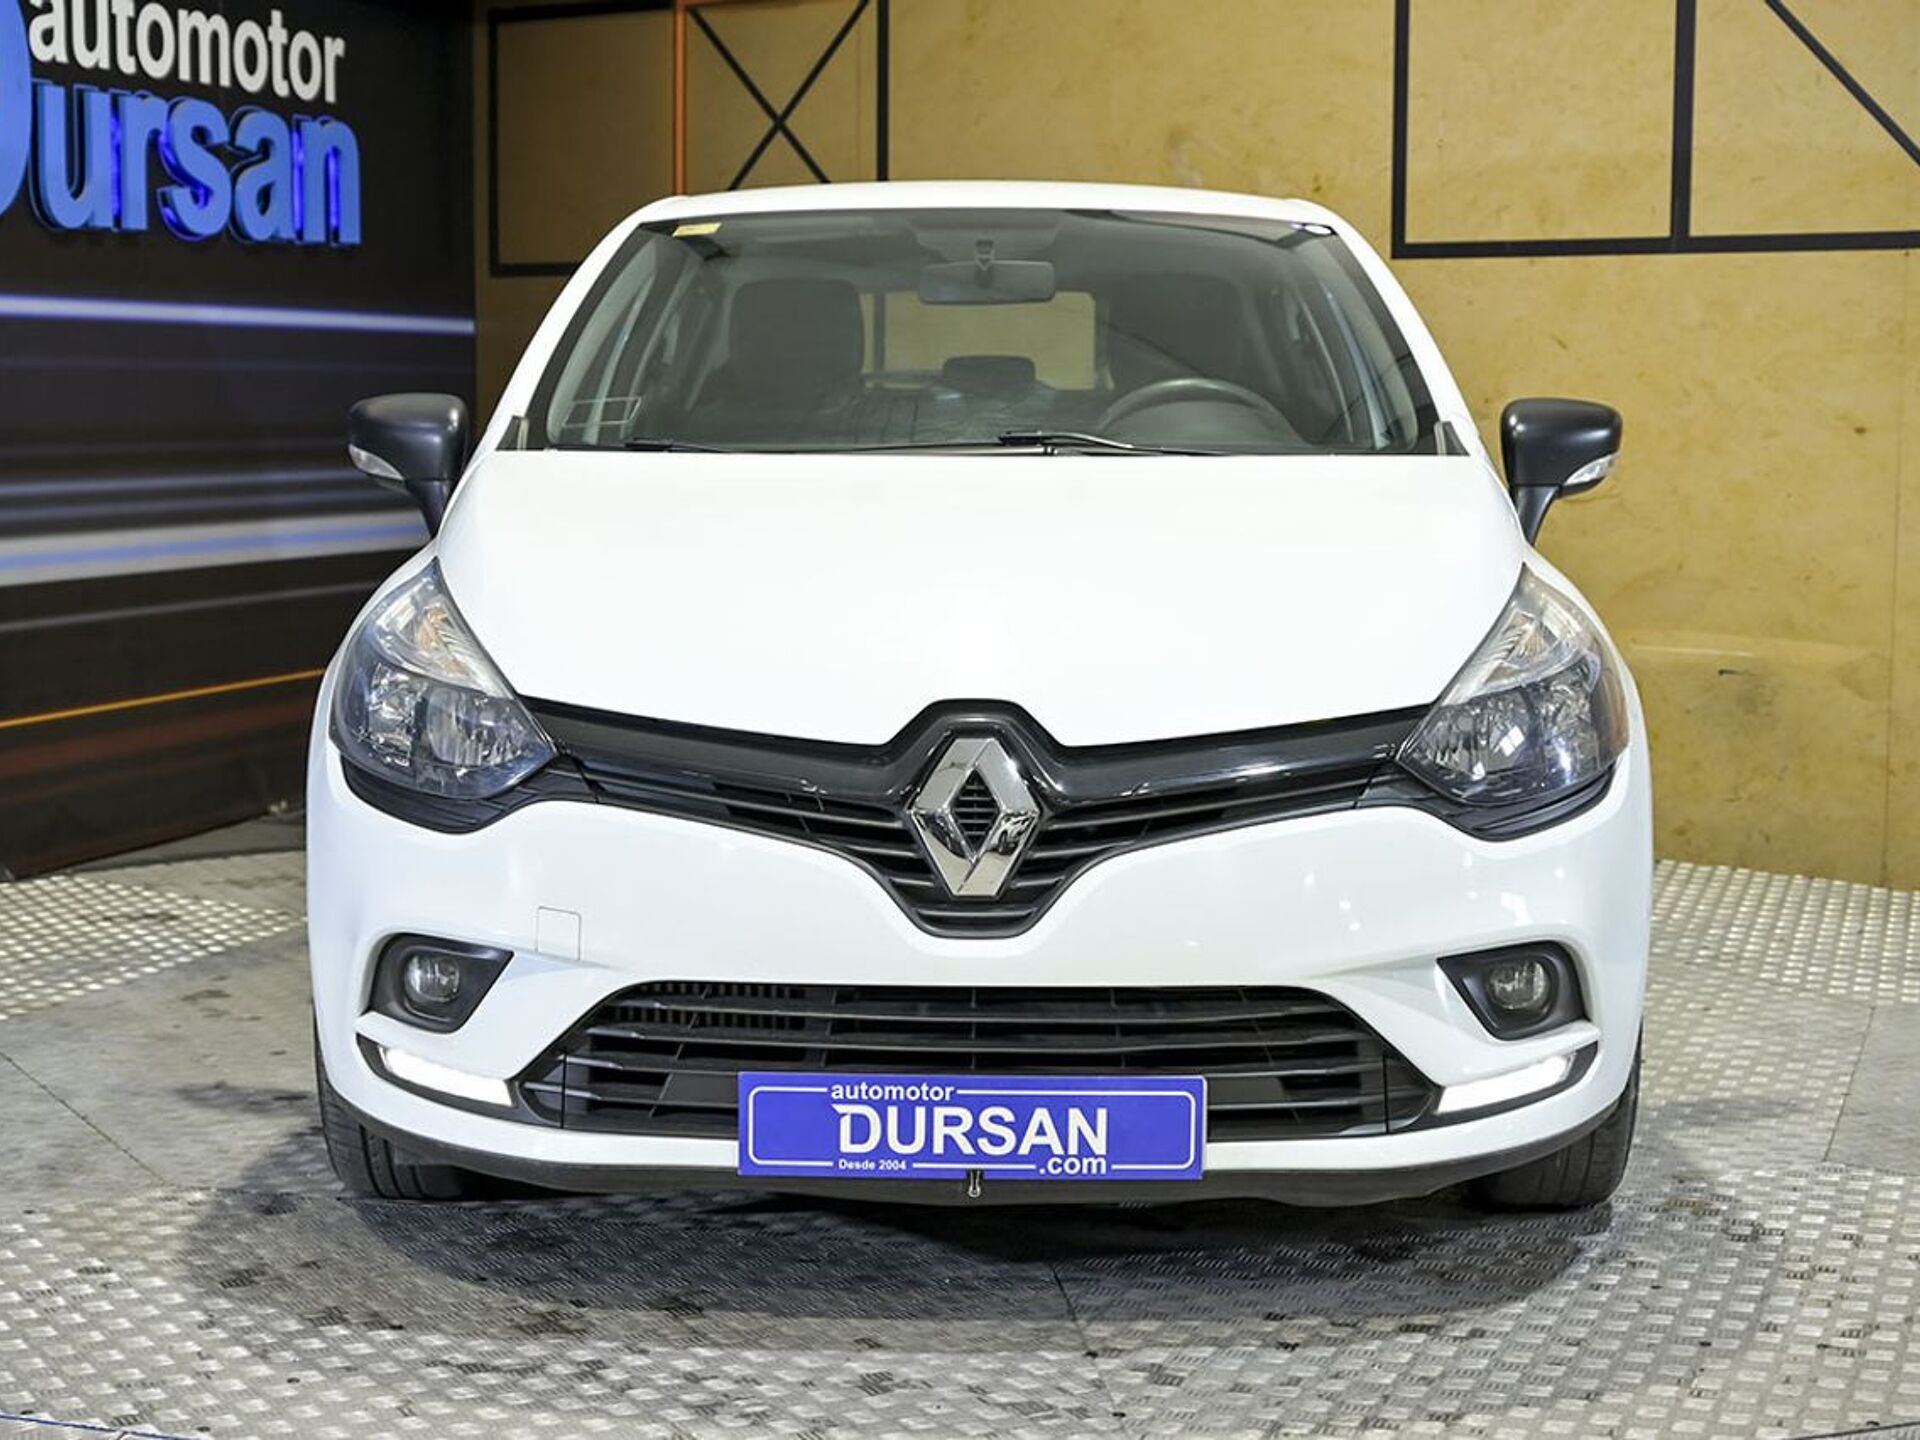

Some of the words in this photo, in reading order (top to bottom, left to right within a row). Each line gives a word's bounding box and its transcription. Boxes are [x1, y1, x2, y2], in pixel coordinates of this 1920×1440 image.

[29, 0, 345, 103] automotor
[830, 1082, 955, 1101] automotor
[831, 1103, 1108, 1156] DURSAN
[838, 1159, 876, 1171] Desde
[878, 1160, 907, 1171] 2004
[1038, 1155, 1107, 1175] .com
